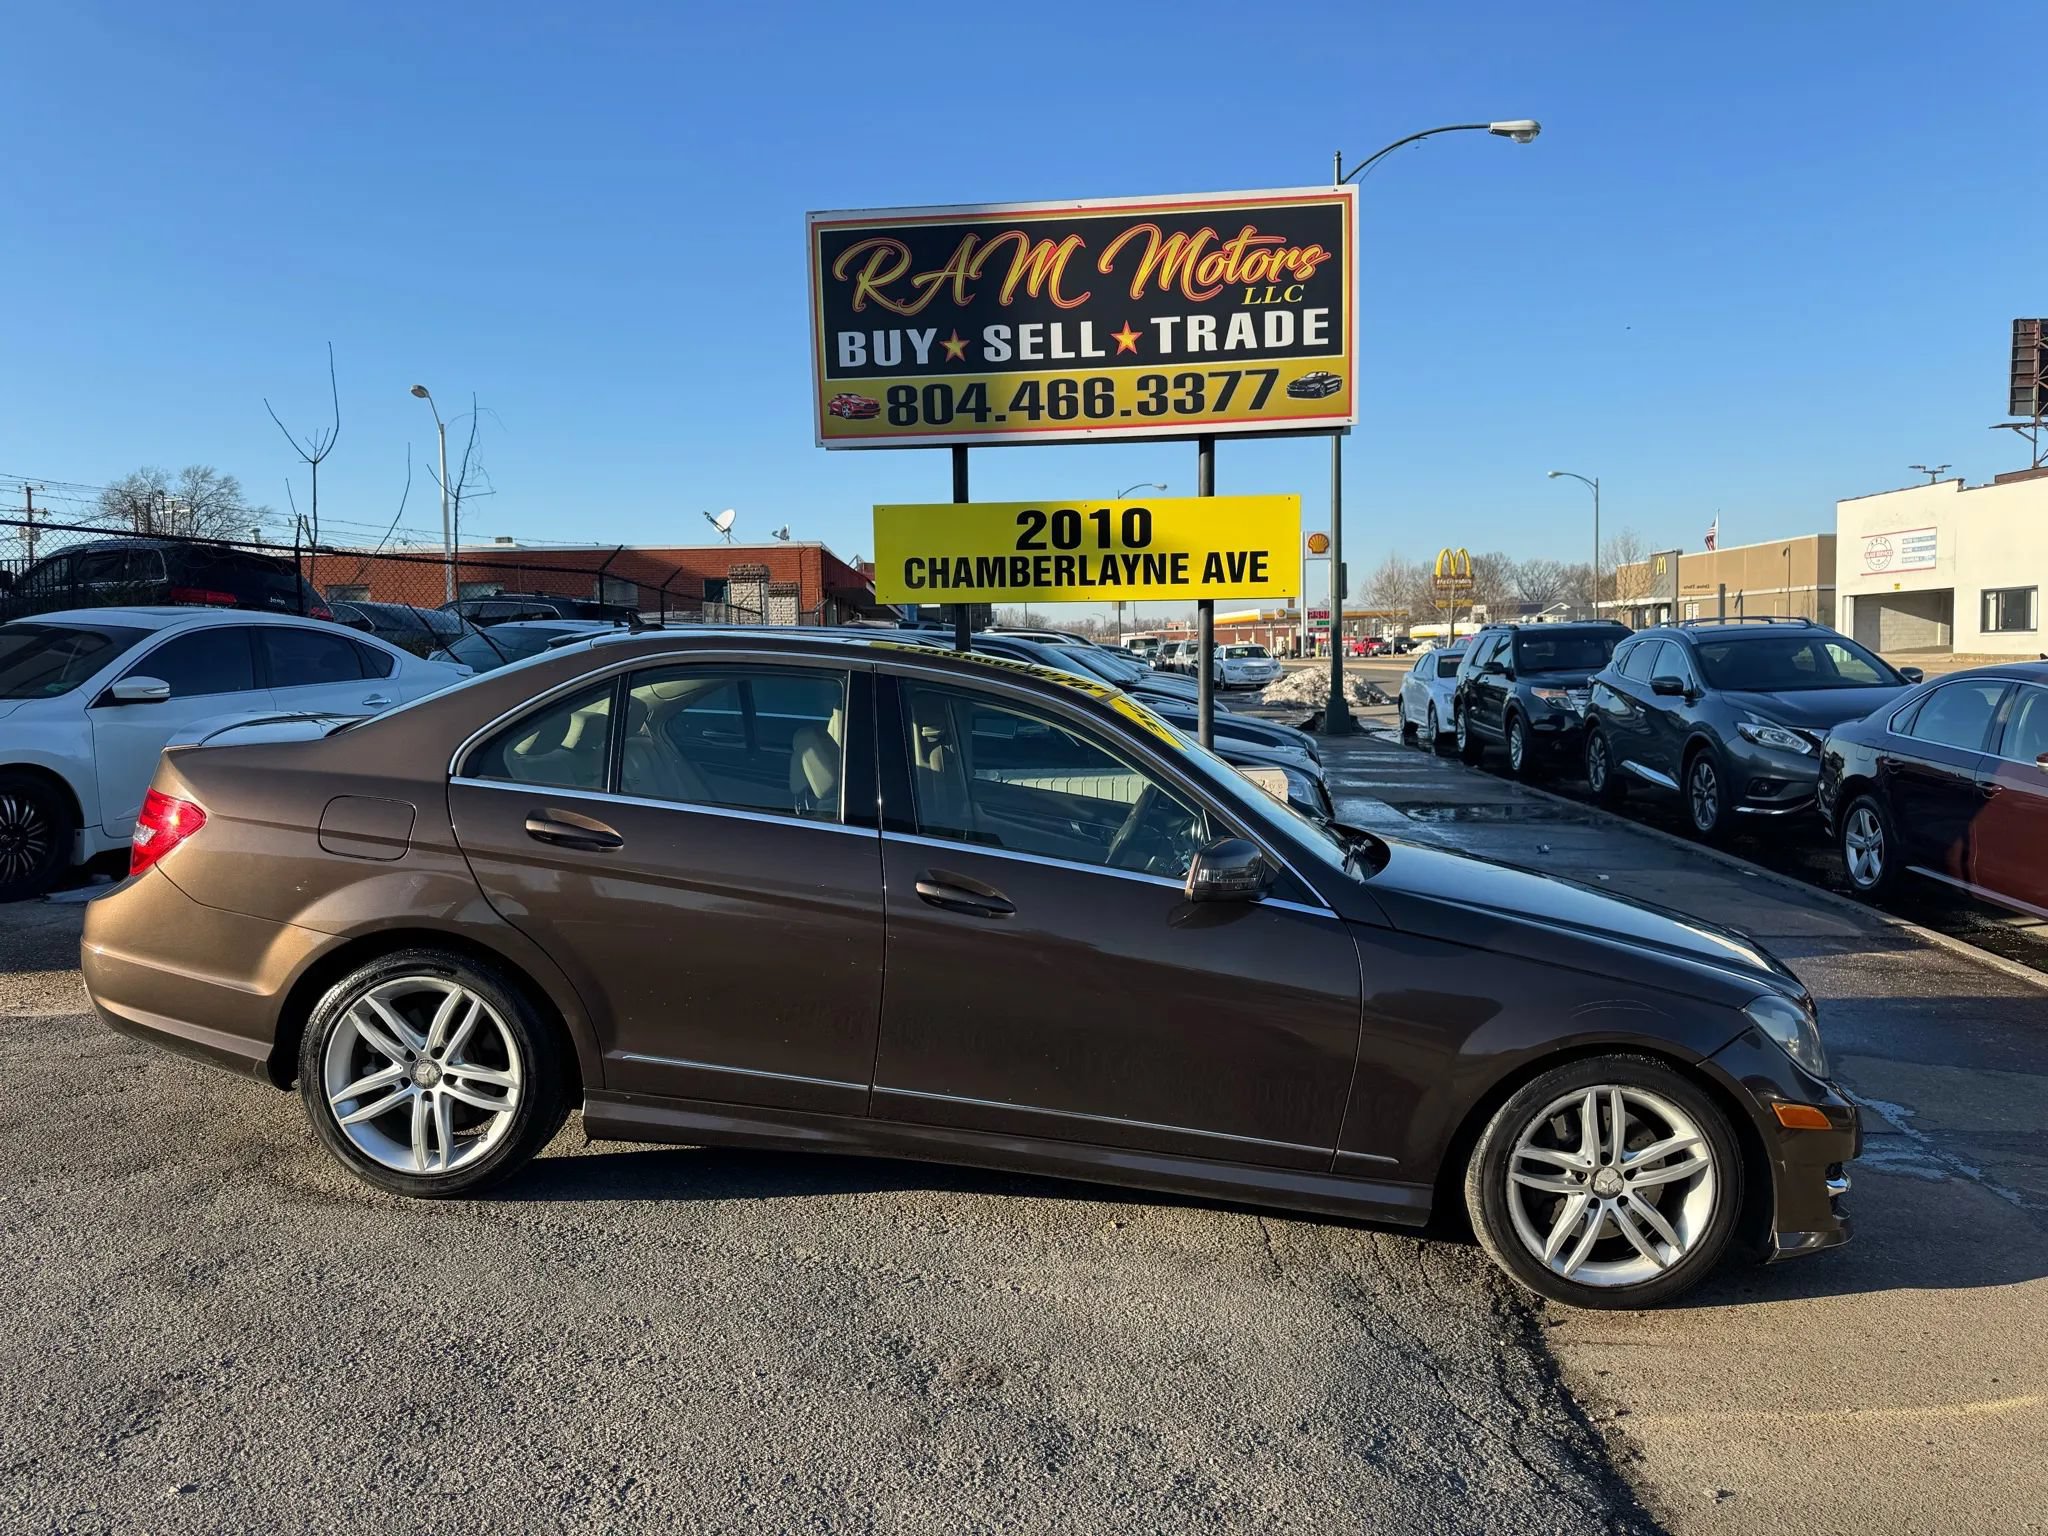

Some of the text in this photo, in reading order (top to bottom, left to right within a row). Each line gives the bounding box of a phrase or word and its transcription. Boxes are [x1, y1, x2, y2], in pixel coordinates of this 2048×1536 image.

[832, 223, 1332, 317] RAM Motors
[1241, 284, 1305, 306] LLC
[837, 307, 1329, 368] BUY SELL TRADE
[886, 368, 1280, 427] 804.466.3377
[1015, 507, 1153, 551] 2010
[904, 550, 1270, 590] CHAMBERLAYNE AVE
